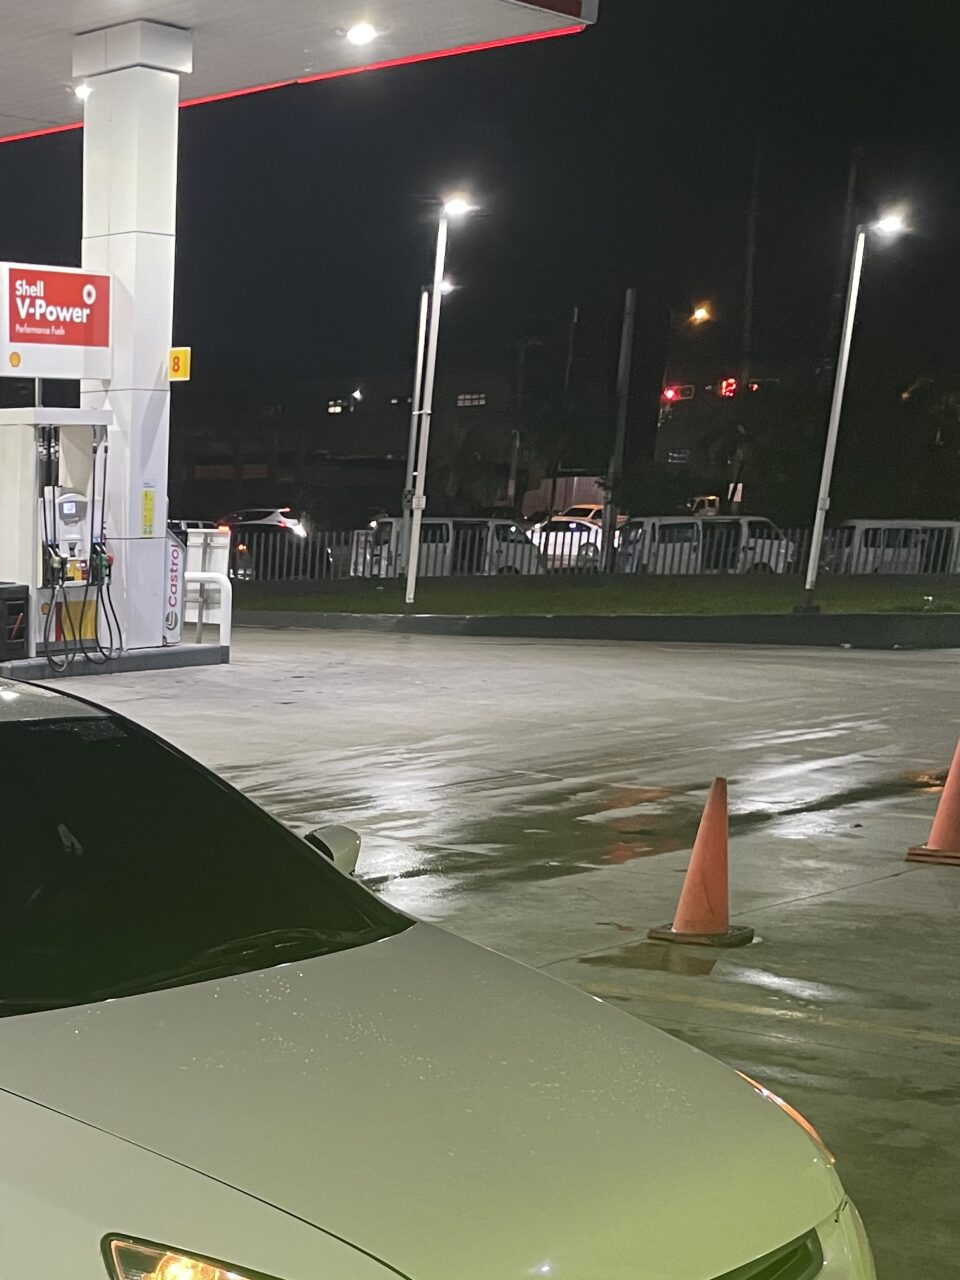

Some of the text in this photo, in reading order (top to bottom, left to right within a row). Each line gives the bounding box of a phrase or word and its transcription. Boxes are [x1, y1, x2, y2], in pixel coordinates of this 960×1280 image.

[15, 279, 44, 297] Shell
[16, 297, 90, 323] V-Power
[172, 355, 180, 373] 8
[168, 544, 179, 607] Castrol
